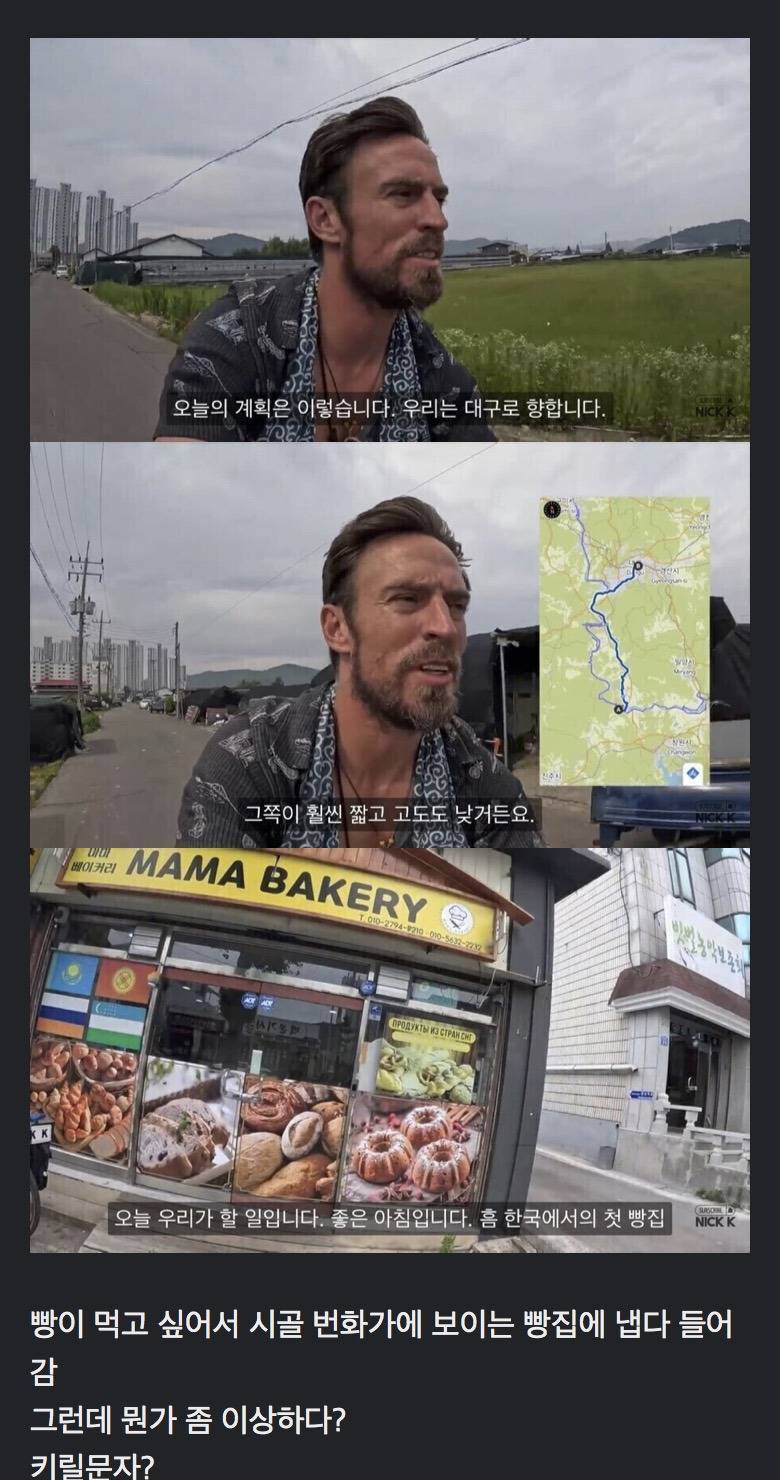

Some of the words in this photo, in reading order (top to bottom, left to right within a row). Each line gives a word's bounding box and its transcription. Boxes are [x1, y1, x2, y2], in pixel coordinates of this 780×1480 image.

[71, 861, 117, 874] 베이커리
[126, 850, 246, 890] MAMA
[259, 865, 428, 924] BAKERY
[392, 1019, 430, 1033] ПРОДУКТЫ
[430, 1027, 439, 1036] ИЗ
[439, 1028, 460, 1039] СТРАН
